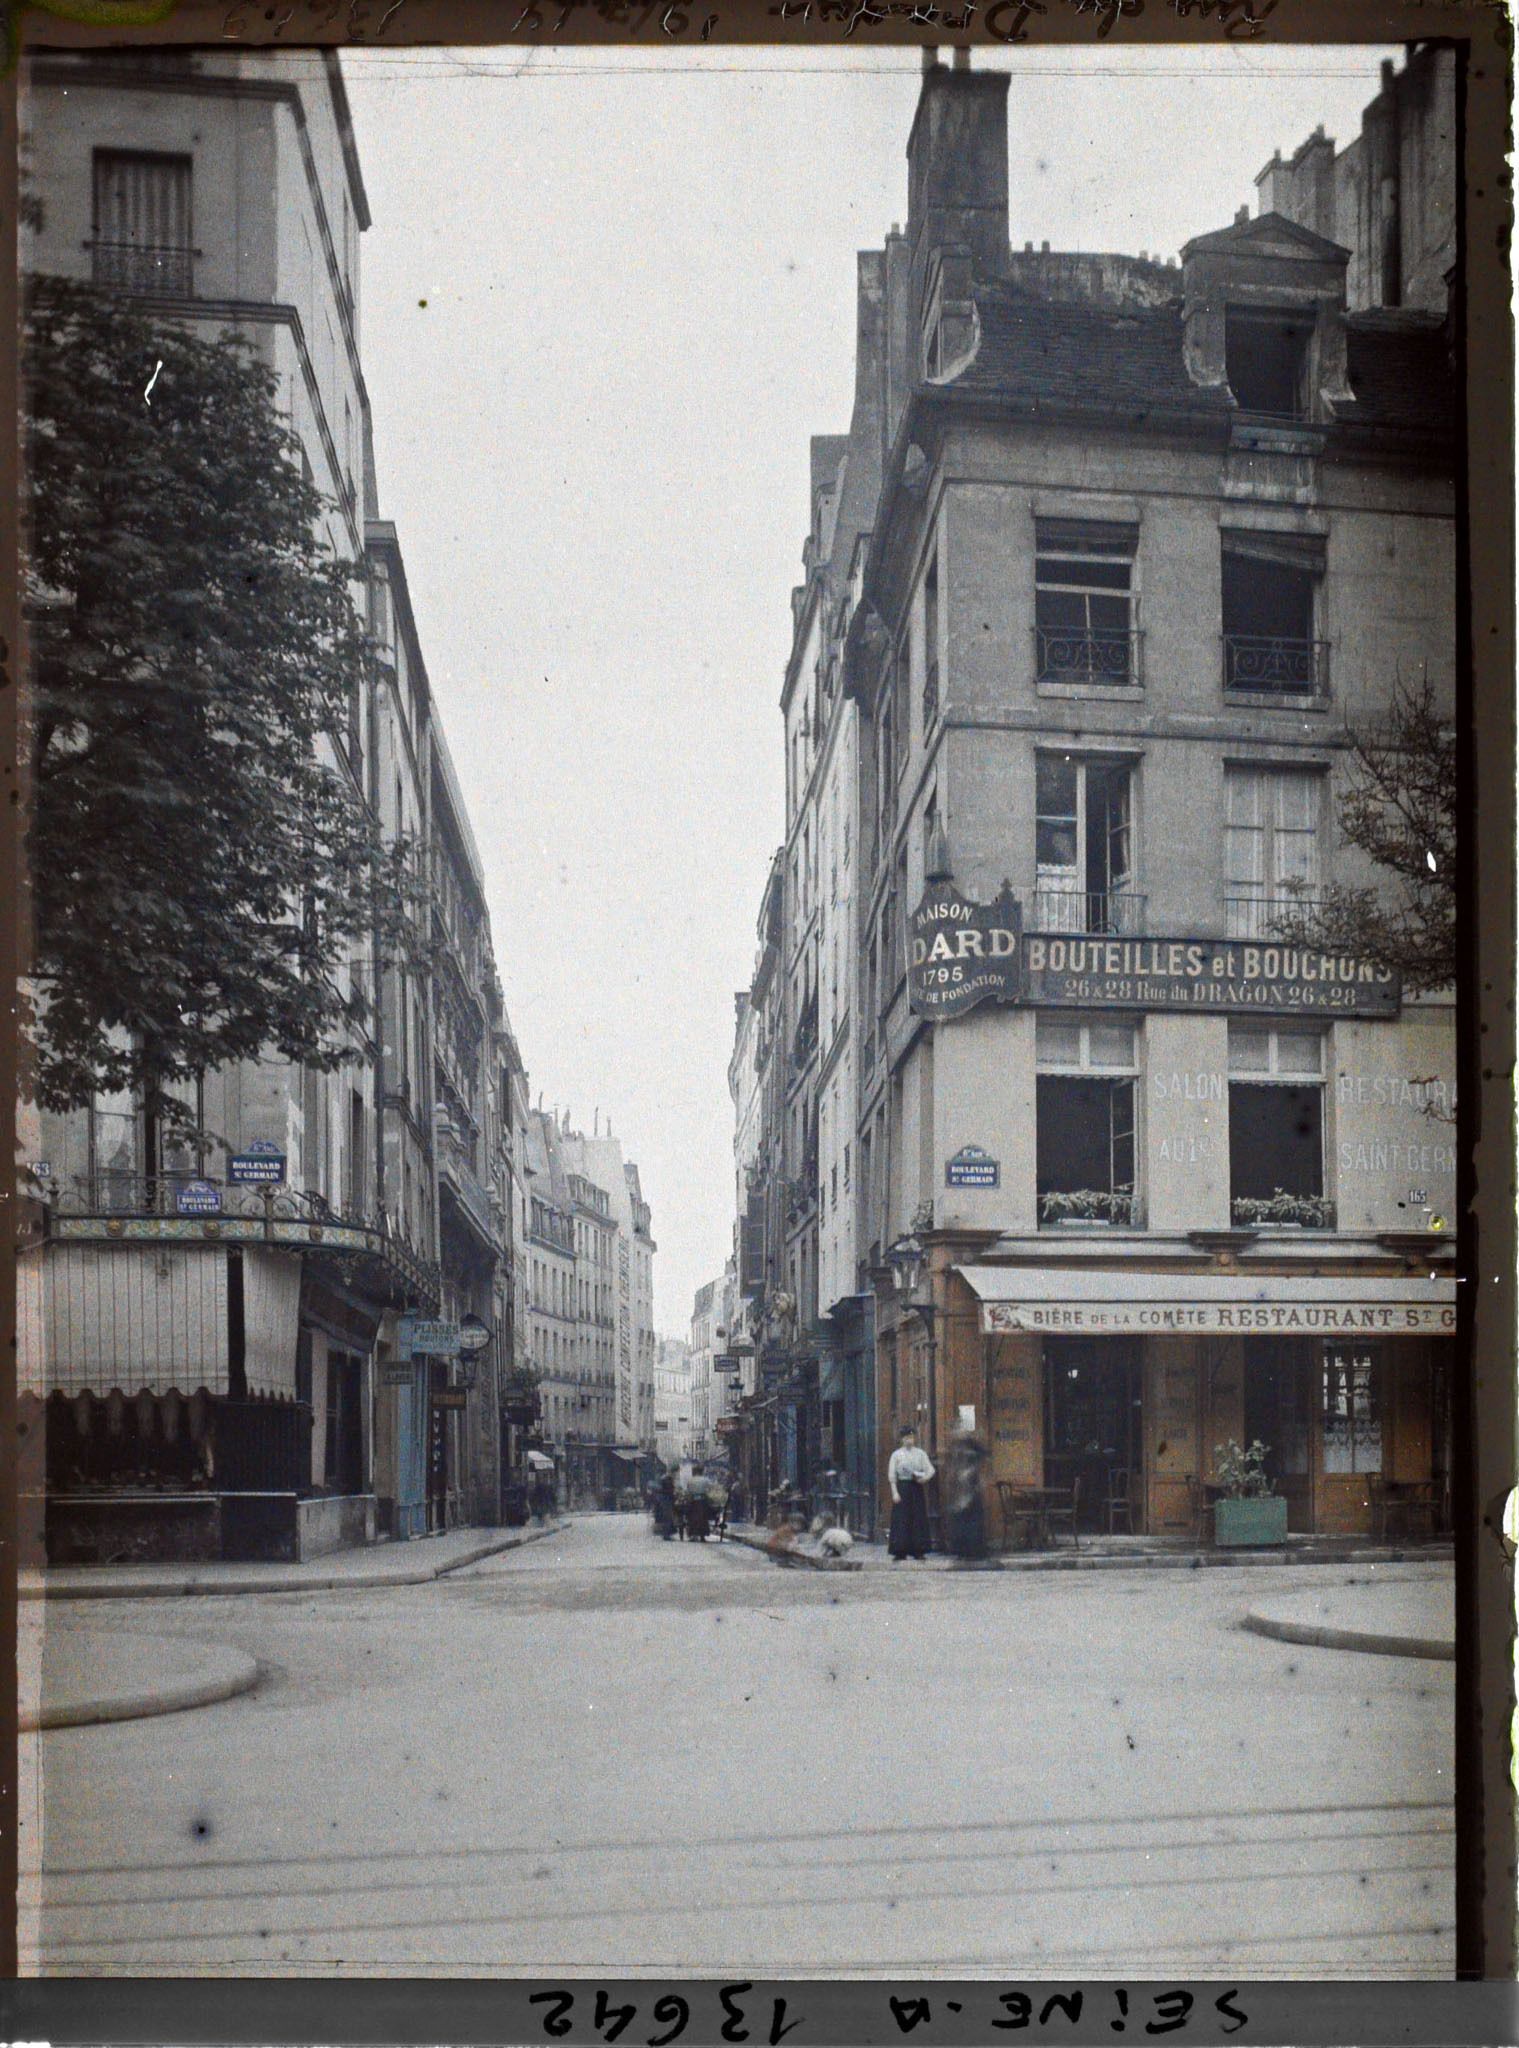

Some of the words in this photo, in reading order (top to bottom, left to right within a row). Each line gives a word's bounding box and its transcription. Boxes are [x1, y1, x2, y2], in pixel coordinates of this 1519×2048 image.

[916, 903, 973, 929] MAISON
[913, 929, 1016, 966] DARD
[1029, 939, 1203, 977] BOUTEILLES
[1212, 951, 1236, 978] et
[922, 966, 963, 986] 1795
[926, 992, 939, 1003] DE
[942, 974, 1006, 1003] FONDATION
[1064, 979, 1089, 998] 26
[1105, 980, 1132, 999] 28
[1136, 981, 1166, 1001] Rue
[1170, 984, 1188, 1001] du
[1193, 982, 1284, 1004] DRAGON
[1288, 986, 1314, 1005] 26
[1330, 987, 1356, 1006] 28
[1153, 1073, 1223, 1100] SALON
[232, 1161, 281, 1170] BOULEVARD
[951, 1165, 995, 1174] BOULEVARD
[1340, 1143, 1400, 1170] SAINT
[243, 1171, 279, 1180] GERMAIN
[961, 1175, 994, 1183] GERMAIN
[1090, 1314, 1107, 1325] DE
[1114, 1314, 1130, 1325] LA
[1218, 1307, 1393, 1327] RESTAURANT
